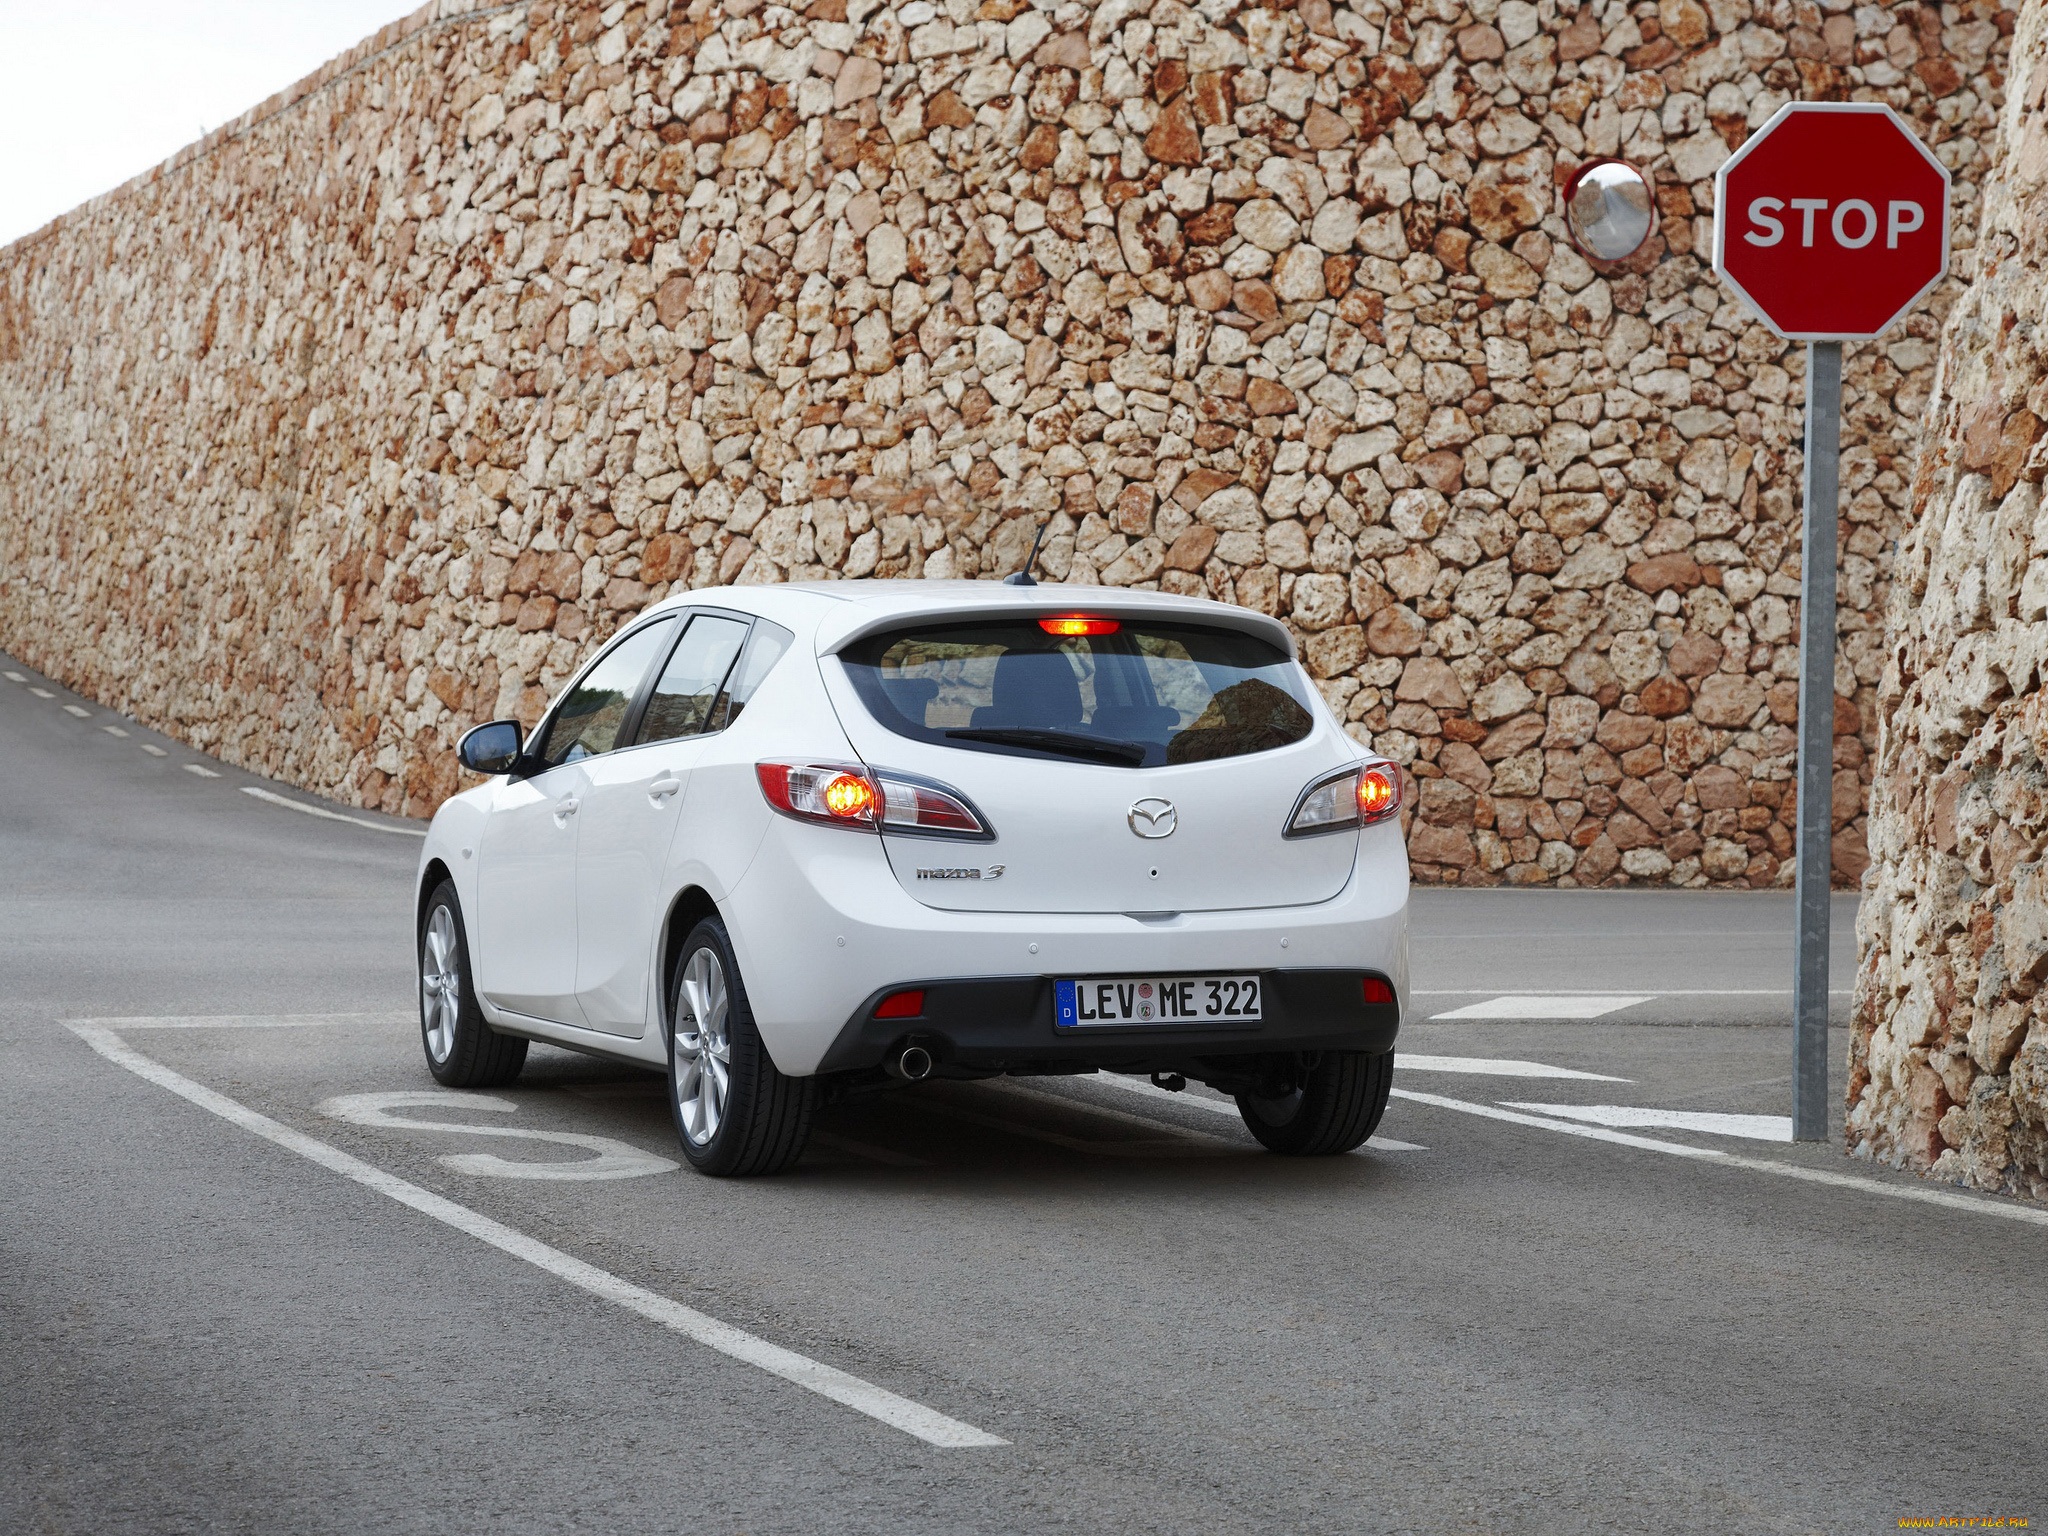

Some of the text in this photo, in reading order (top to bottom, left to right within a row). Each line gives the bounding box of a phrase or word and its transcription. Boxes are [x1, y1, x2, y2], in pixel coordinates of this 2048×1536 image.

[1743, 196, 1924, 249] STOP
[982, 863, 1006, 881] 3
[1063, 1008, 1072, 1018] D
[1077, 983, 1135, 1019] LEV
[1159, 982, 1197, 1017] ME
[1204, 981, 1259, 1015] 322
